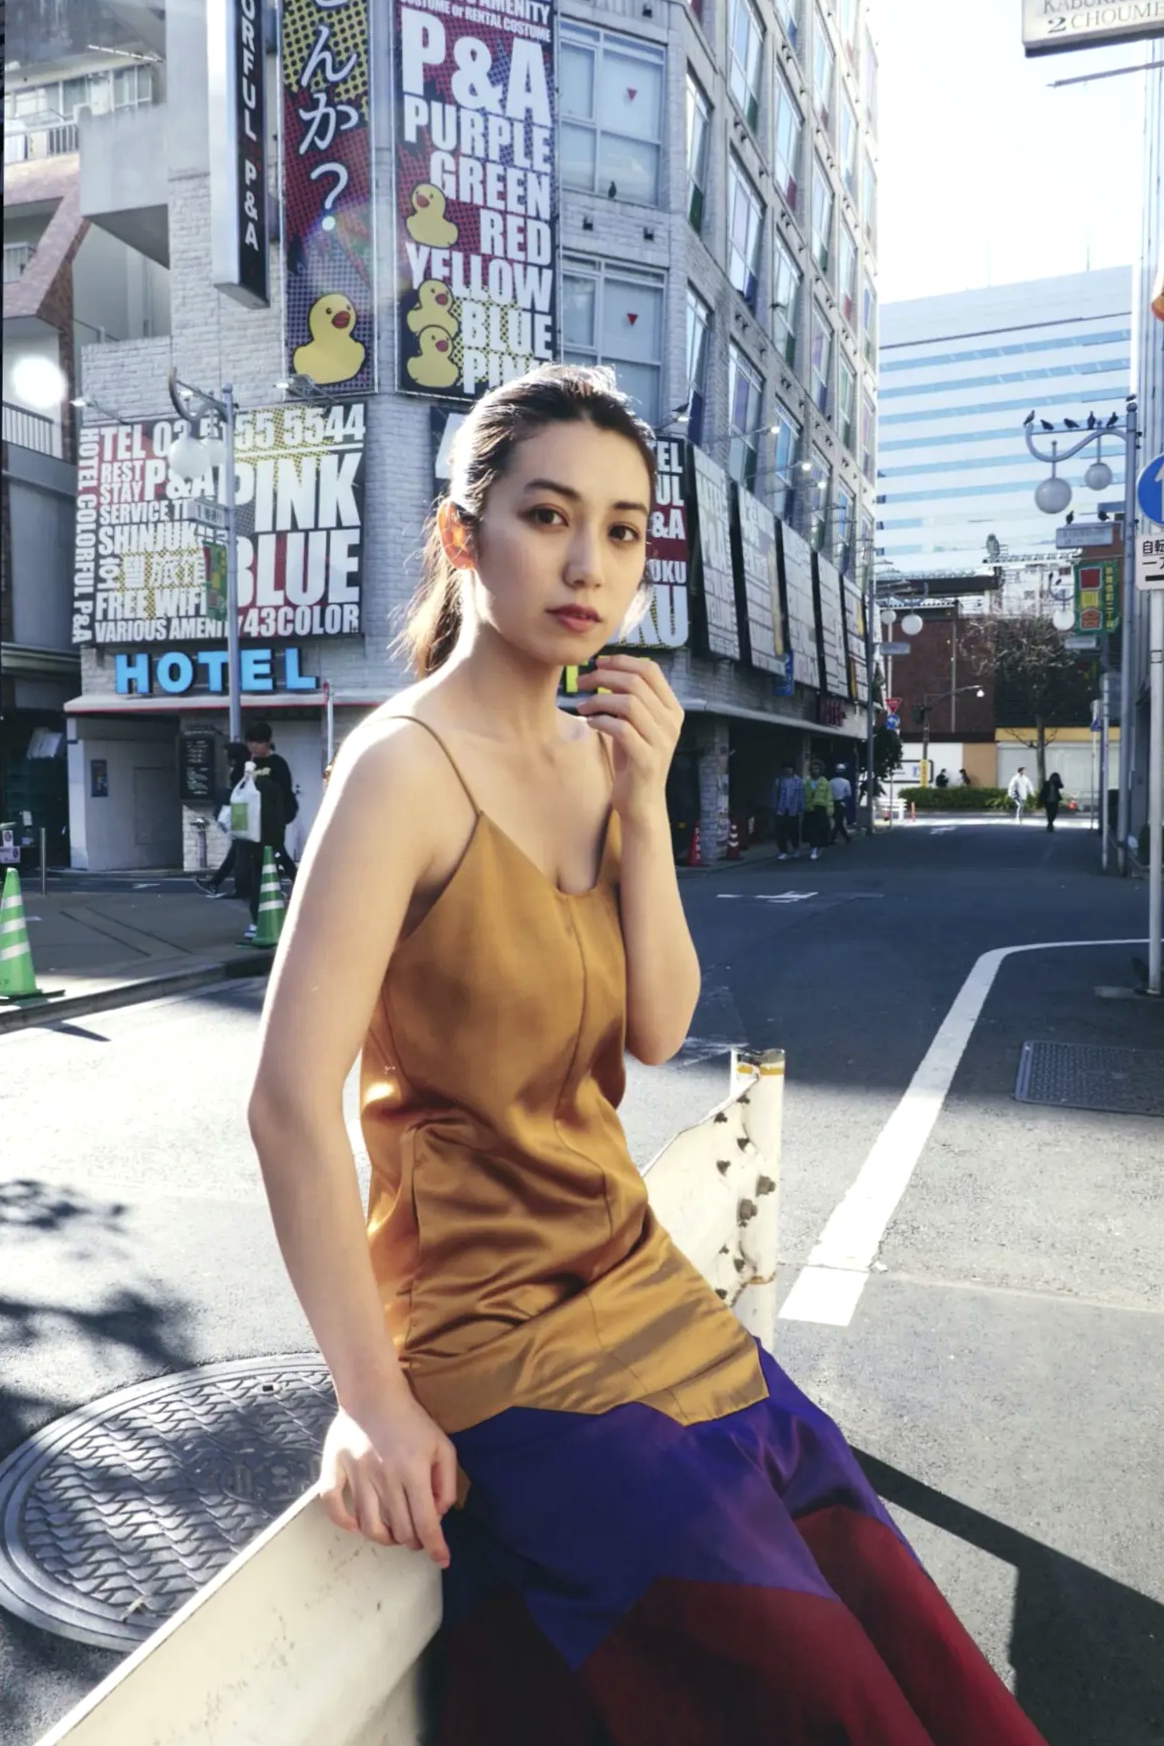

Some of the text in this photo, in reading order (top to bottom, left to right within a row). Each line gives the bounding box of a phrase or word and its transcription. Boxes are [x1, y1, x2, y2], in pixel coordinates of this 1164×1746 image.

[402, 0, 450, 16] TUME
[465, 6, 503, 29] RENTAL
[503, 18, 551, 43] COSTUME
[1043, 0, 1132, 14] KABU
[1047, 16, 1067, 34] 2
[401, 7, 553, 128] P&A
[298, 0, 359, 231] んか？
[404, 94, 551, 172] PURPLE
[244, 158, 259, 251] P&A
[430, 150, 551, 221] GREEN
[479, 208, 552, 267] RED
[405, 241, 554, 313] YELLOW
[461, 300, 554, 360] BLUE
[462, 349, 548, 395] PIN
[100, 423, 146, 461] TEL
[283, 402, 366, 447] 5544
[101, 460, 144, 484] REST
[144, 458, 215, 501] P&A
[649, 440, 684, 474] EL
[98, 500, 169, 526] SERVICE
[99, 481, 143, 504] STAY
[217, 452, 362, 533] PINK
[654, 473, 684, 508] UL
[71, 428, 100, 644] HOTEL COLORFUL P&A
[651, 507, 686, 541] &A
[225, 528, 361, 609] BLUE
[95, 585, 207, 621] FREE WIFI
[95, 614, 242, 643] VARIOUS AMENI
[114, 647, 317, 694] HOTEL
